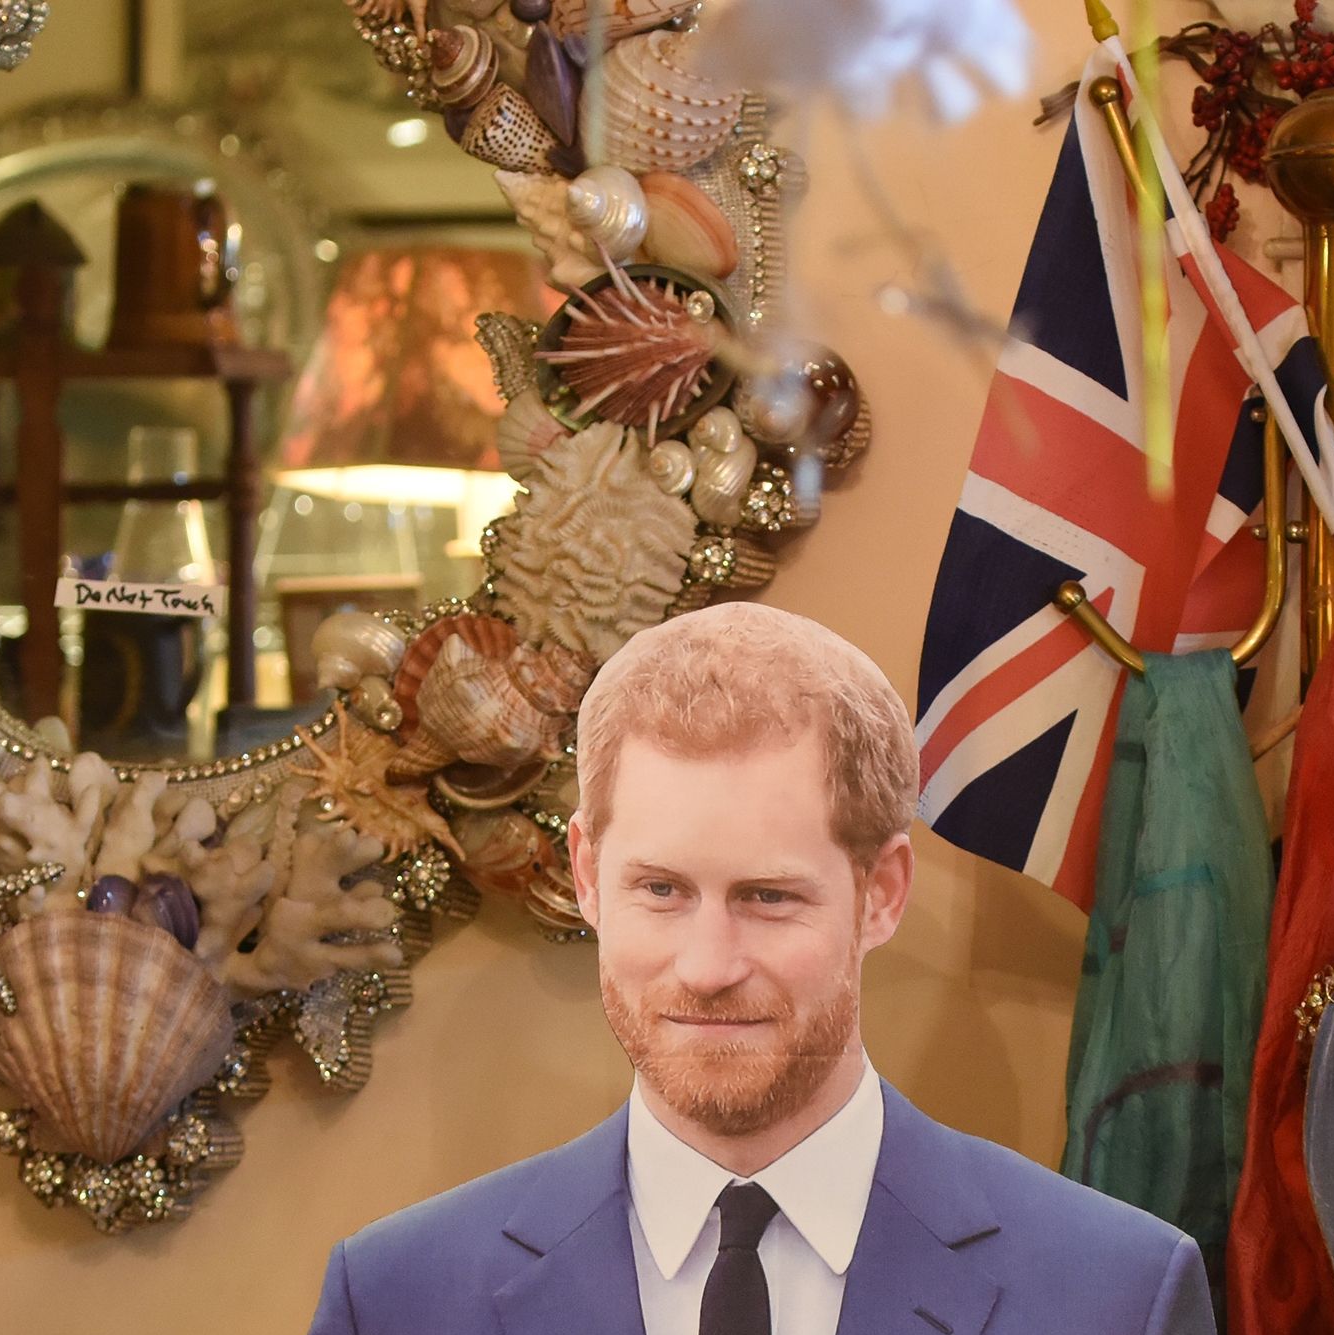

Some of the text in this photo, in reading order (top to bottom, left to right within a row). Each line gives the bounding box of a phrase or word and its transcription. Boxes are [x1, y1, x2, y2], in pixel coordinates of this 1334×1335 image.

[75, 582, 215, 615] Do Not Touch
